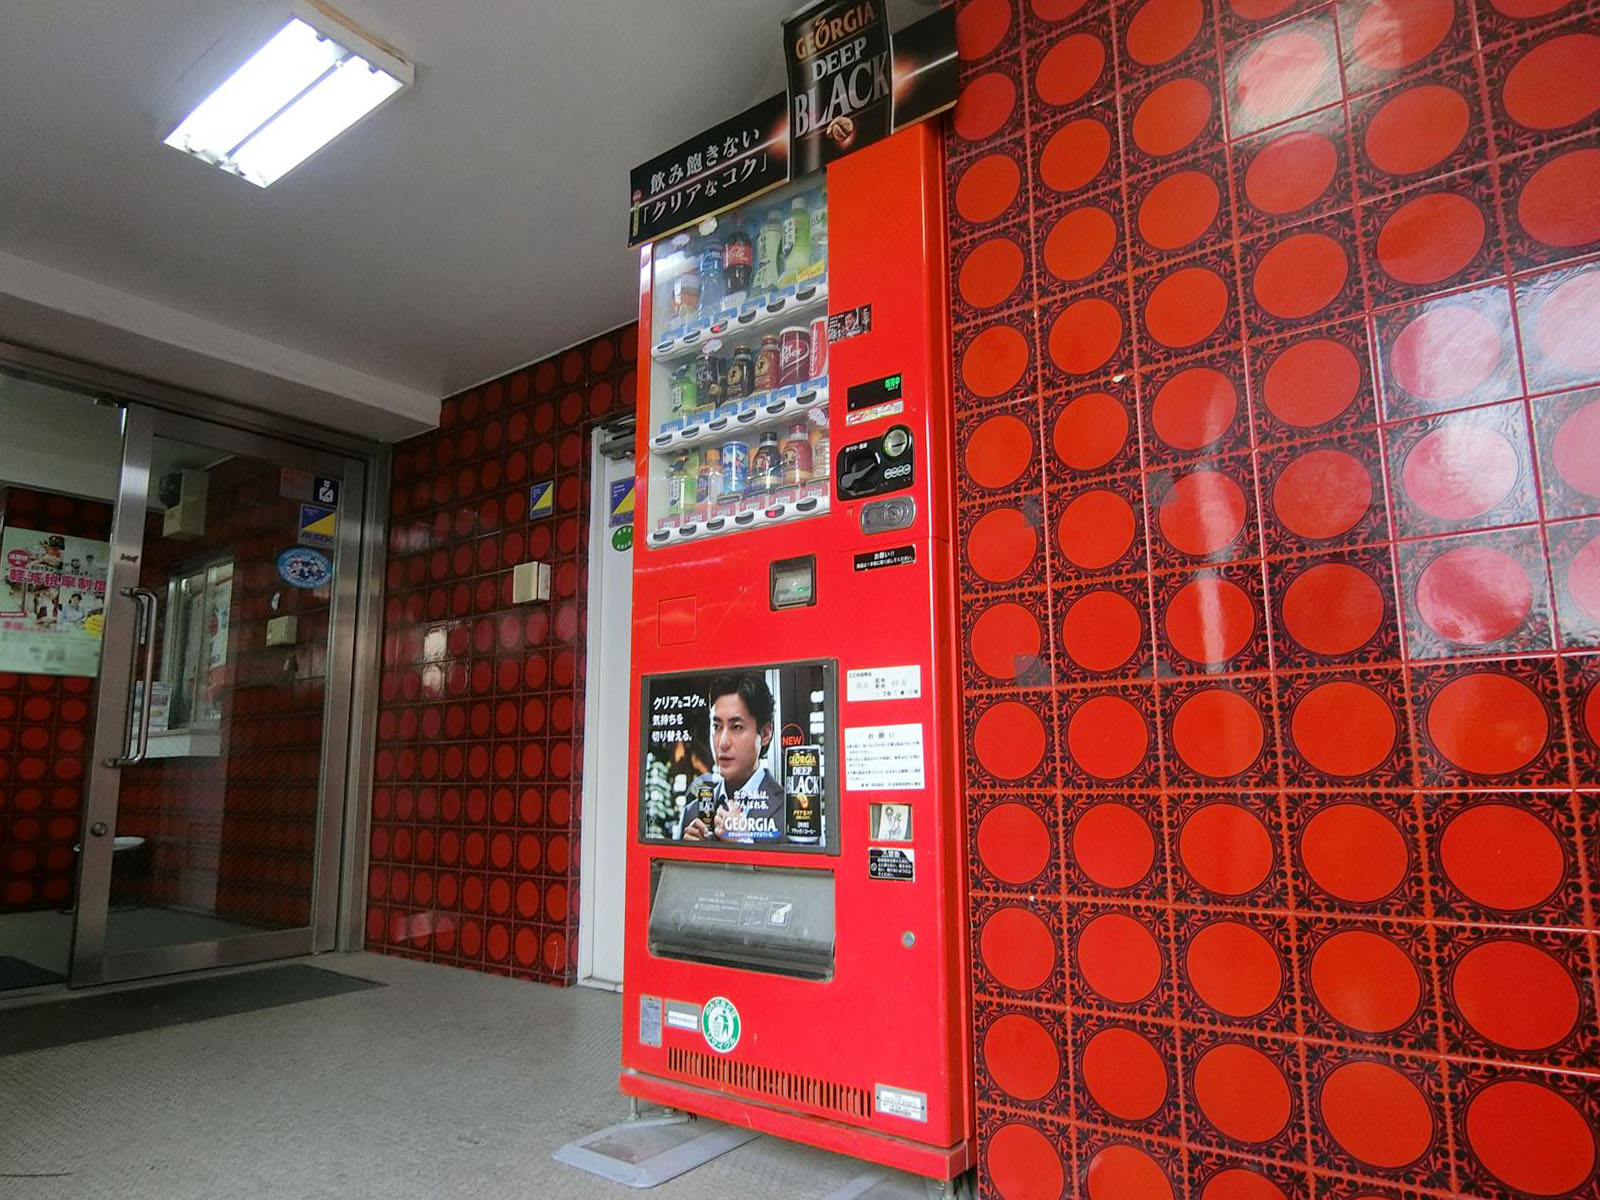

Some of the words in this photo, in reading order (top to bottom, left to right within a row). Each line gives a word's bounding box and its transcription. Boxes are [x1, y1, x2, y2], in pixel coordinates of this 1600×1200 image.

[795, 1, 877, 60] GEORGIA
[812, 37, 867, 82] DEEP
[794, 50, 890, 139] BLACK
[650, 127, 761, 195] 飲み飽きない
[641, 151, 768, 225] 「クリアなコク」
[652, 713, 684, 726] 気持ちを
[782, 735, 802, 746] NEW
[787, 753, 817, 766] GEORGIA
[792, 766, 813, 776] DEEP
[787, 776, 820, 794] BLACK
[725, 817, 777, 832] GEORGIA
